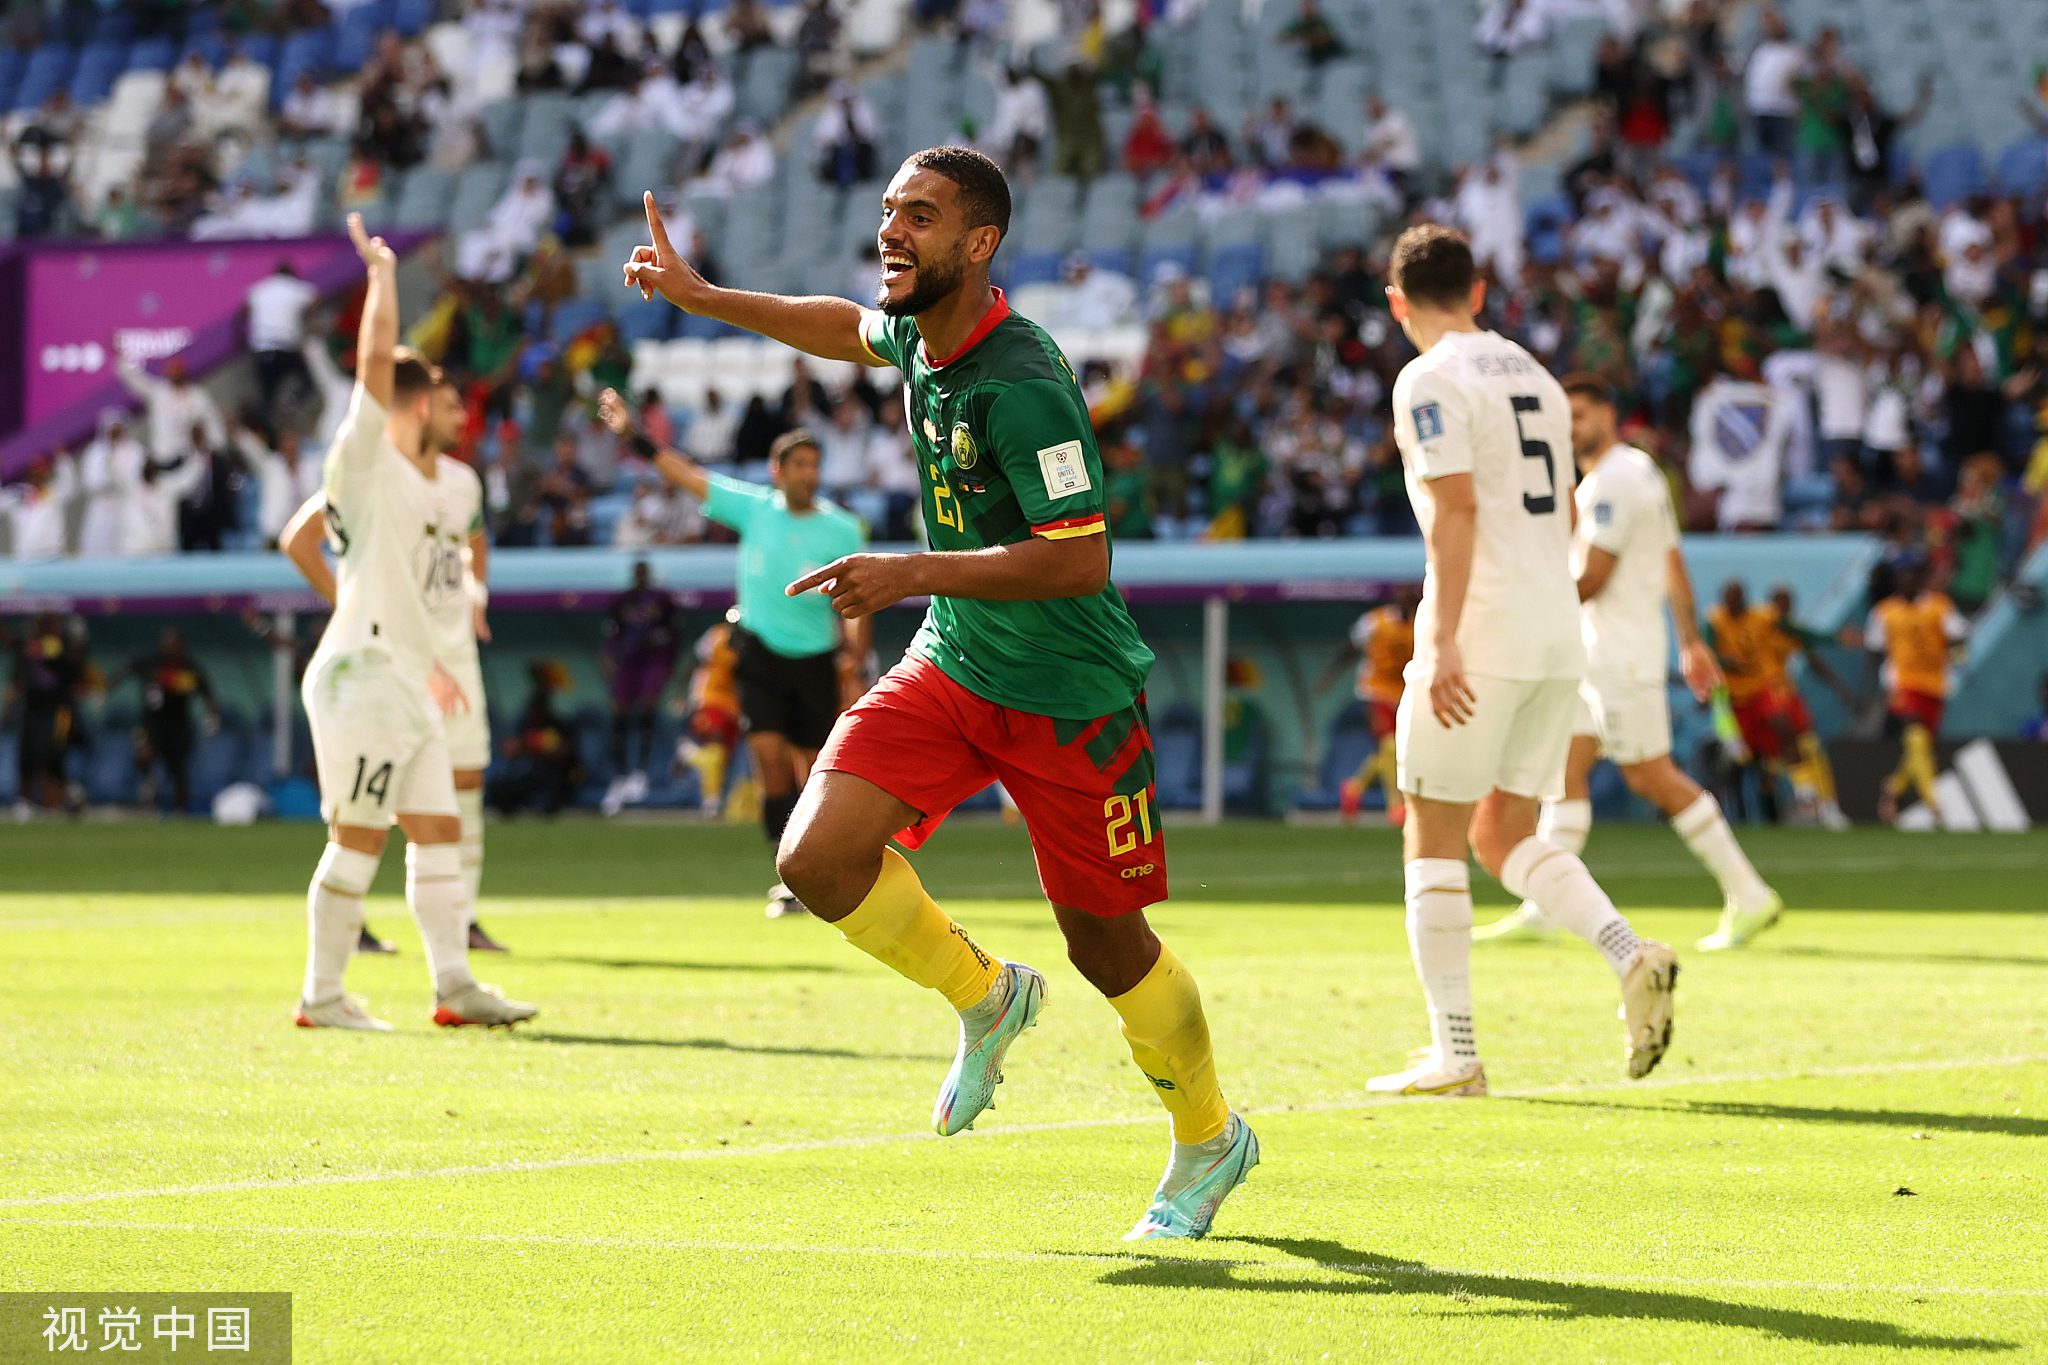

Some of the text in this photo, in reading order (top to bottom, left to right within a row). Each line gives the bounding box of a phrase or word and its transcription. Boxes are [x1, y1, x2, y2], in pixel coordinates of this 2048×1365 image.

[1510, 395, 1556, 515] 5
[929, 463, 964, 534] 21
[350, 755, 393, 808] 14
[1104, 787, 1153, 858] 21
[1120, 863, 1155, 879] one
